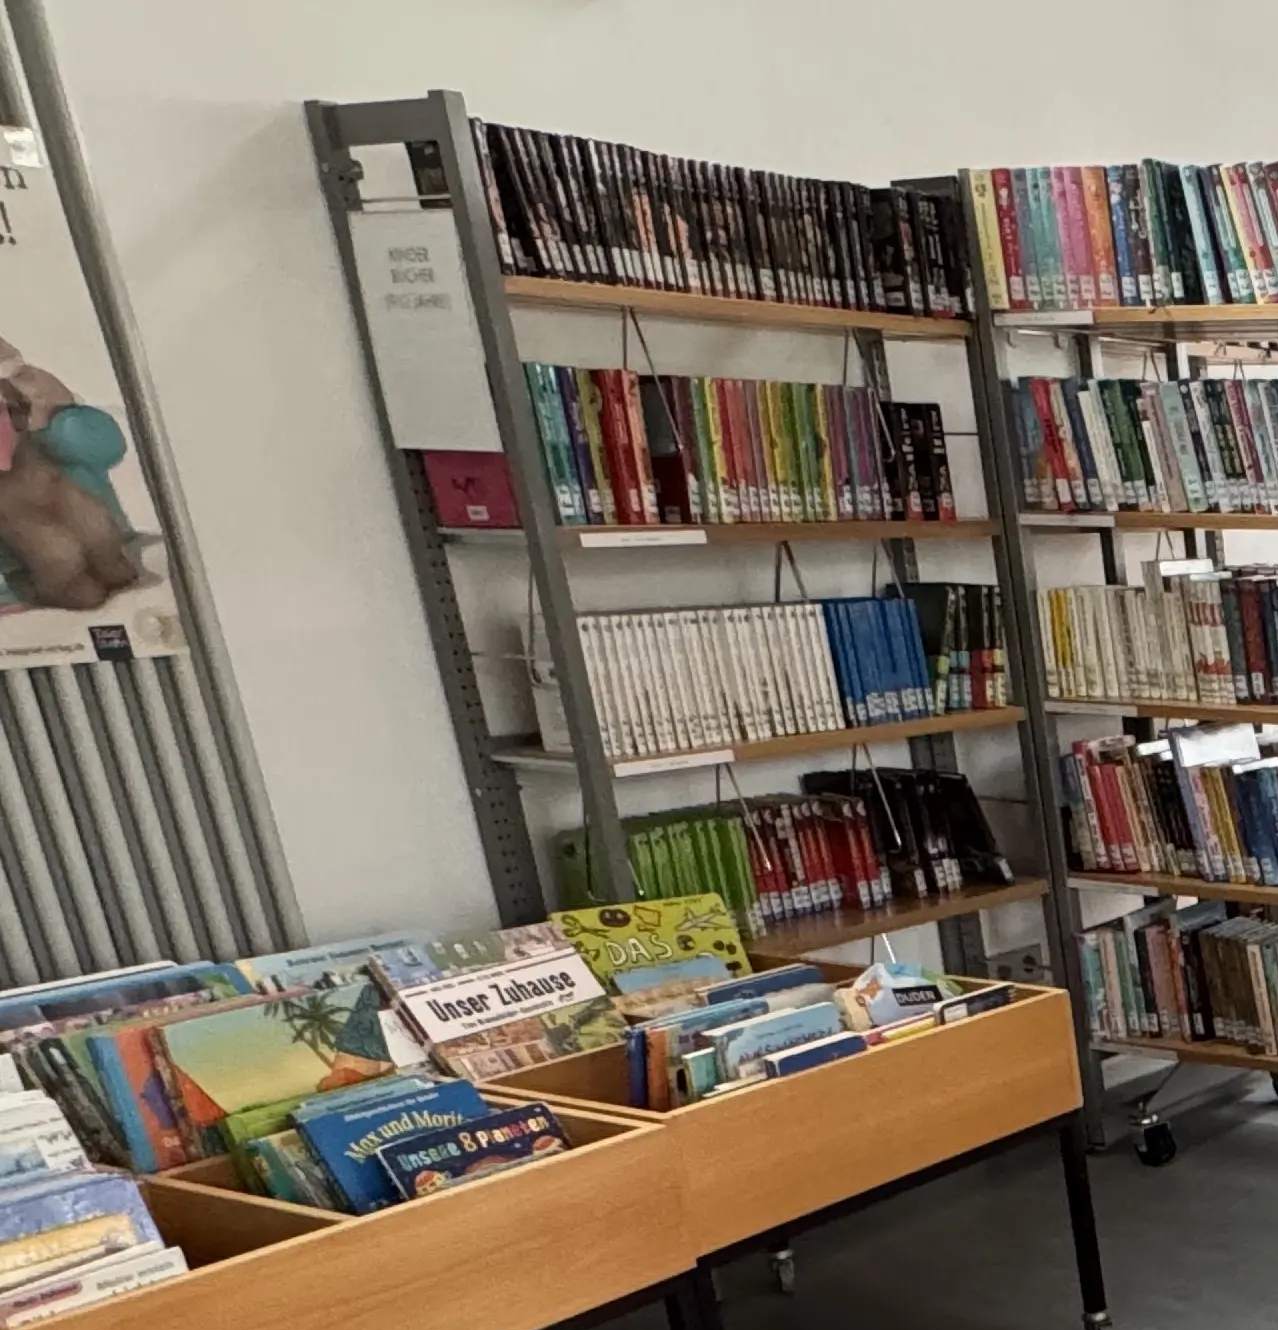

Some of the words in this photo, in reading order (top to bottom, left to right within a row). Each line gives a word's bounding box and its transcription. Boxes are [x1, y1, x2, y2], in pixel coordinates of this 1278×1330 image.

[603, 933, 673, 967] DAS
[426, 991, 491, 1023] Unser
[488, 969, 577, 1007] Zuhause
[344, 1131, 377, 1164] Max
[381, 1114, 415, 1140] und
[459, 1131, 478, 1152] 8
[476, 1114, 549, 1148] Planeten
